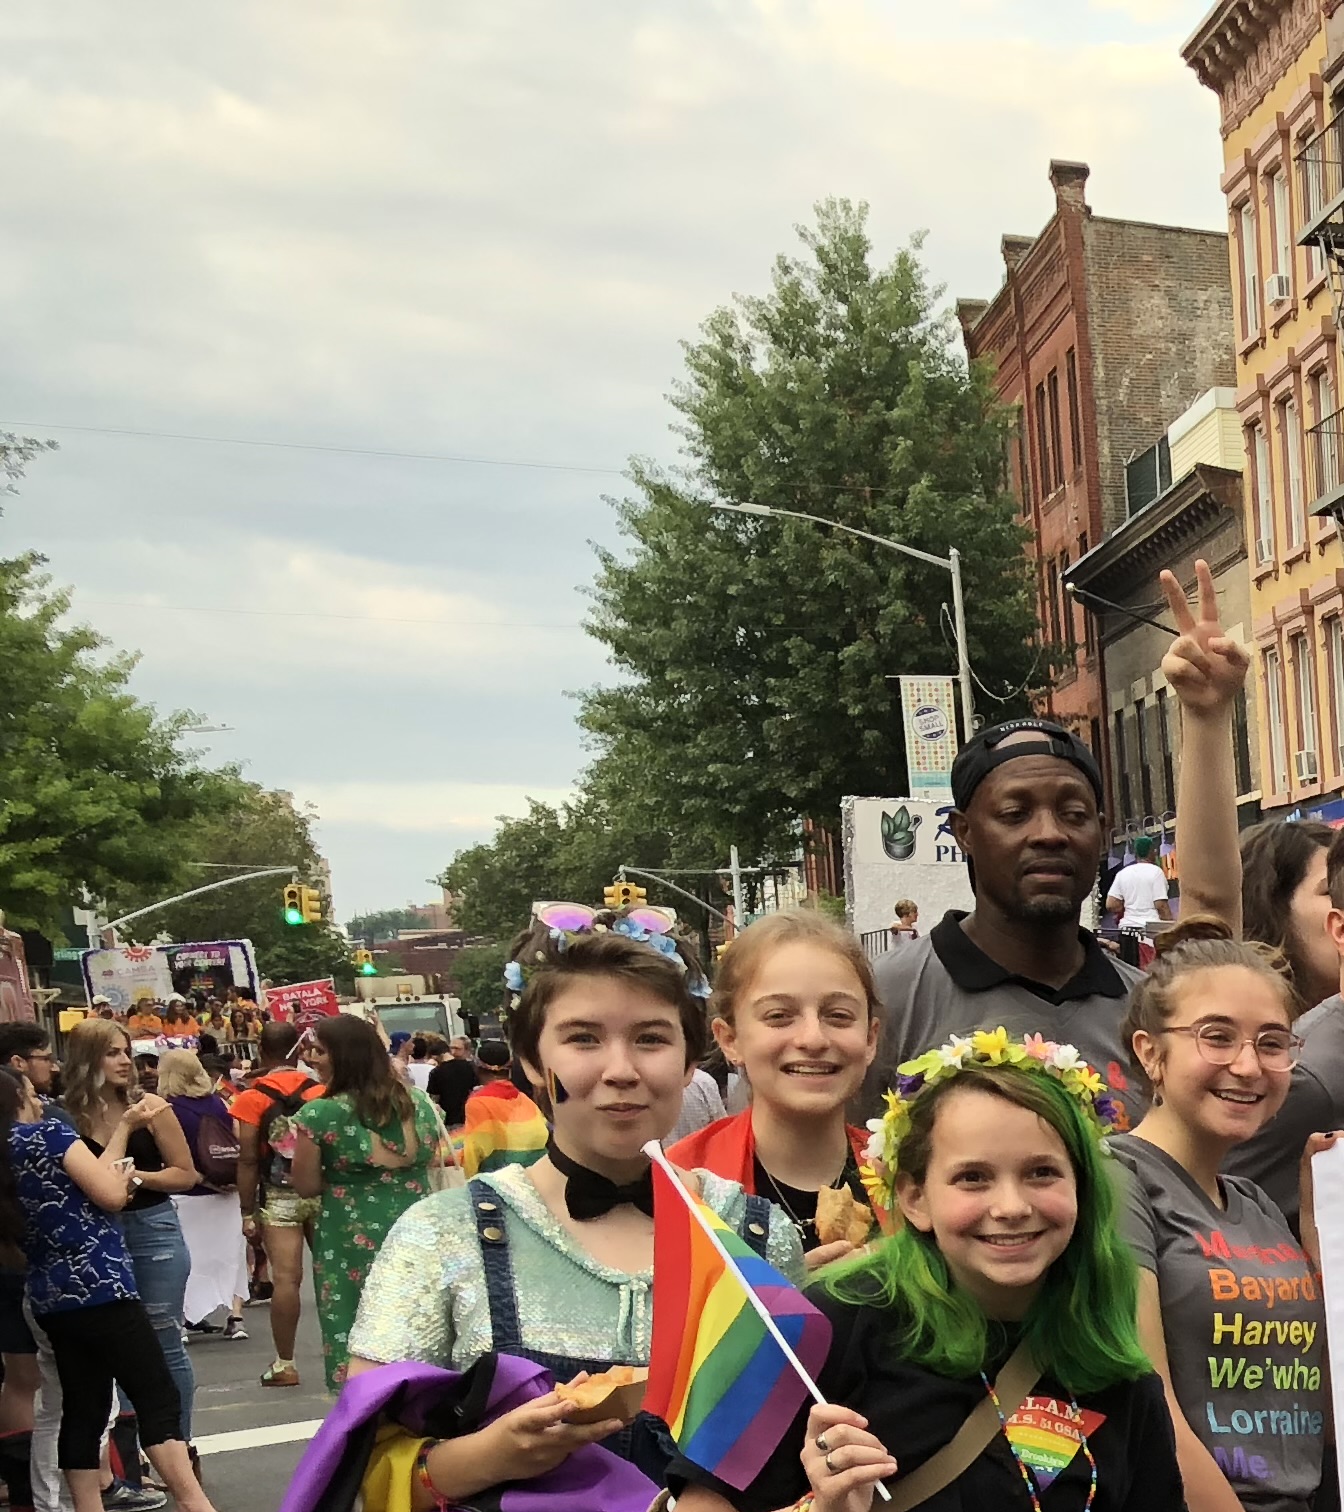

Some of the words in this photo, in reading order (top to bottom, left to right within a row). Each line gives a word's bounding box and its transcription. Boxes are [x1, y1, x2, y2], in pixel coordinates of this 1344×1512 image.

[919, 722, 943, 731] SMALL
[282, 988, 322, 1000] BATALA
[302, 996, 328, 1007] YORK
[1208, 1268, 1316, 1308] Bayard
[1212, 1312, 1317, 1353] Harvey
[1207, 1356, 1320, 1391] We'wha
[1054, 1421, 1080, 1440] GSA
[1207, 1401, 1323, 1435] Lorraine
[1213, 1446, 1275, 1480] Me.
